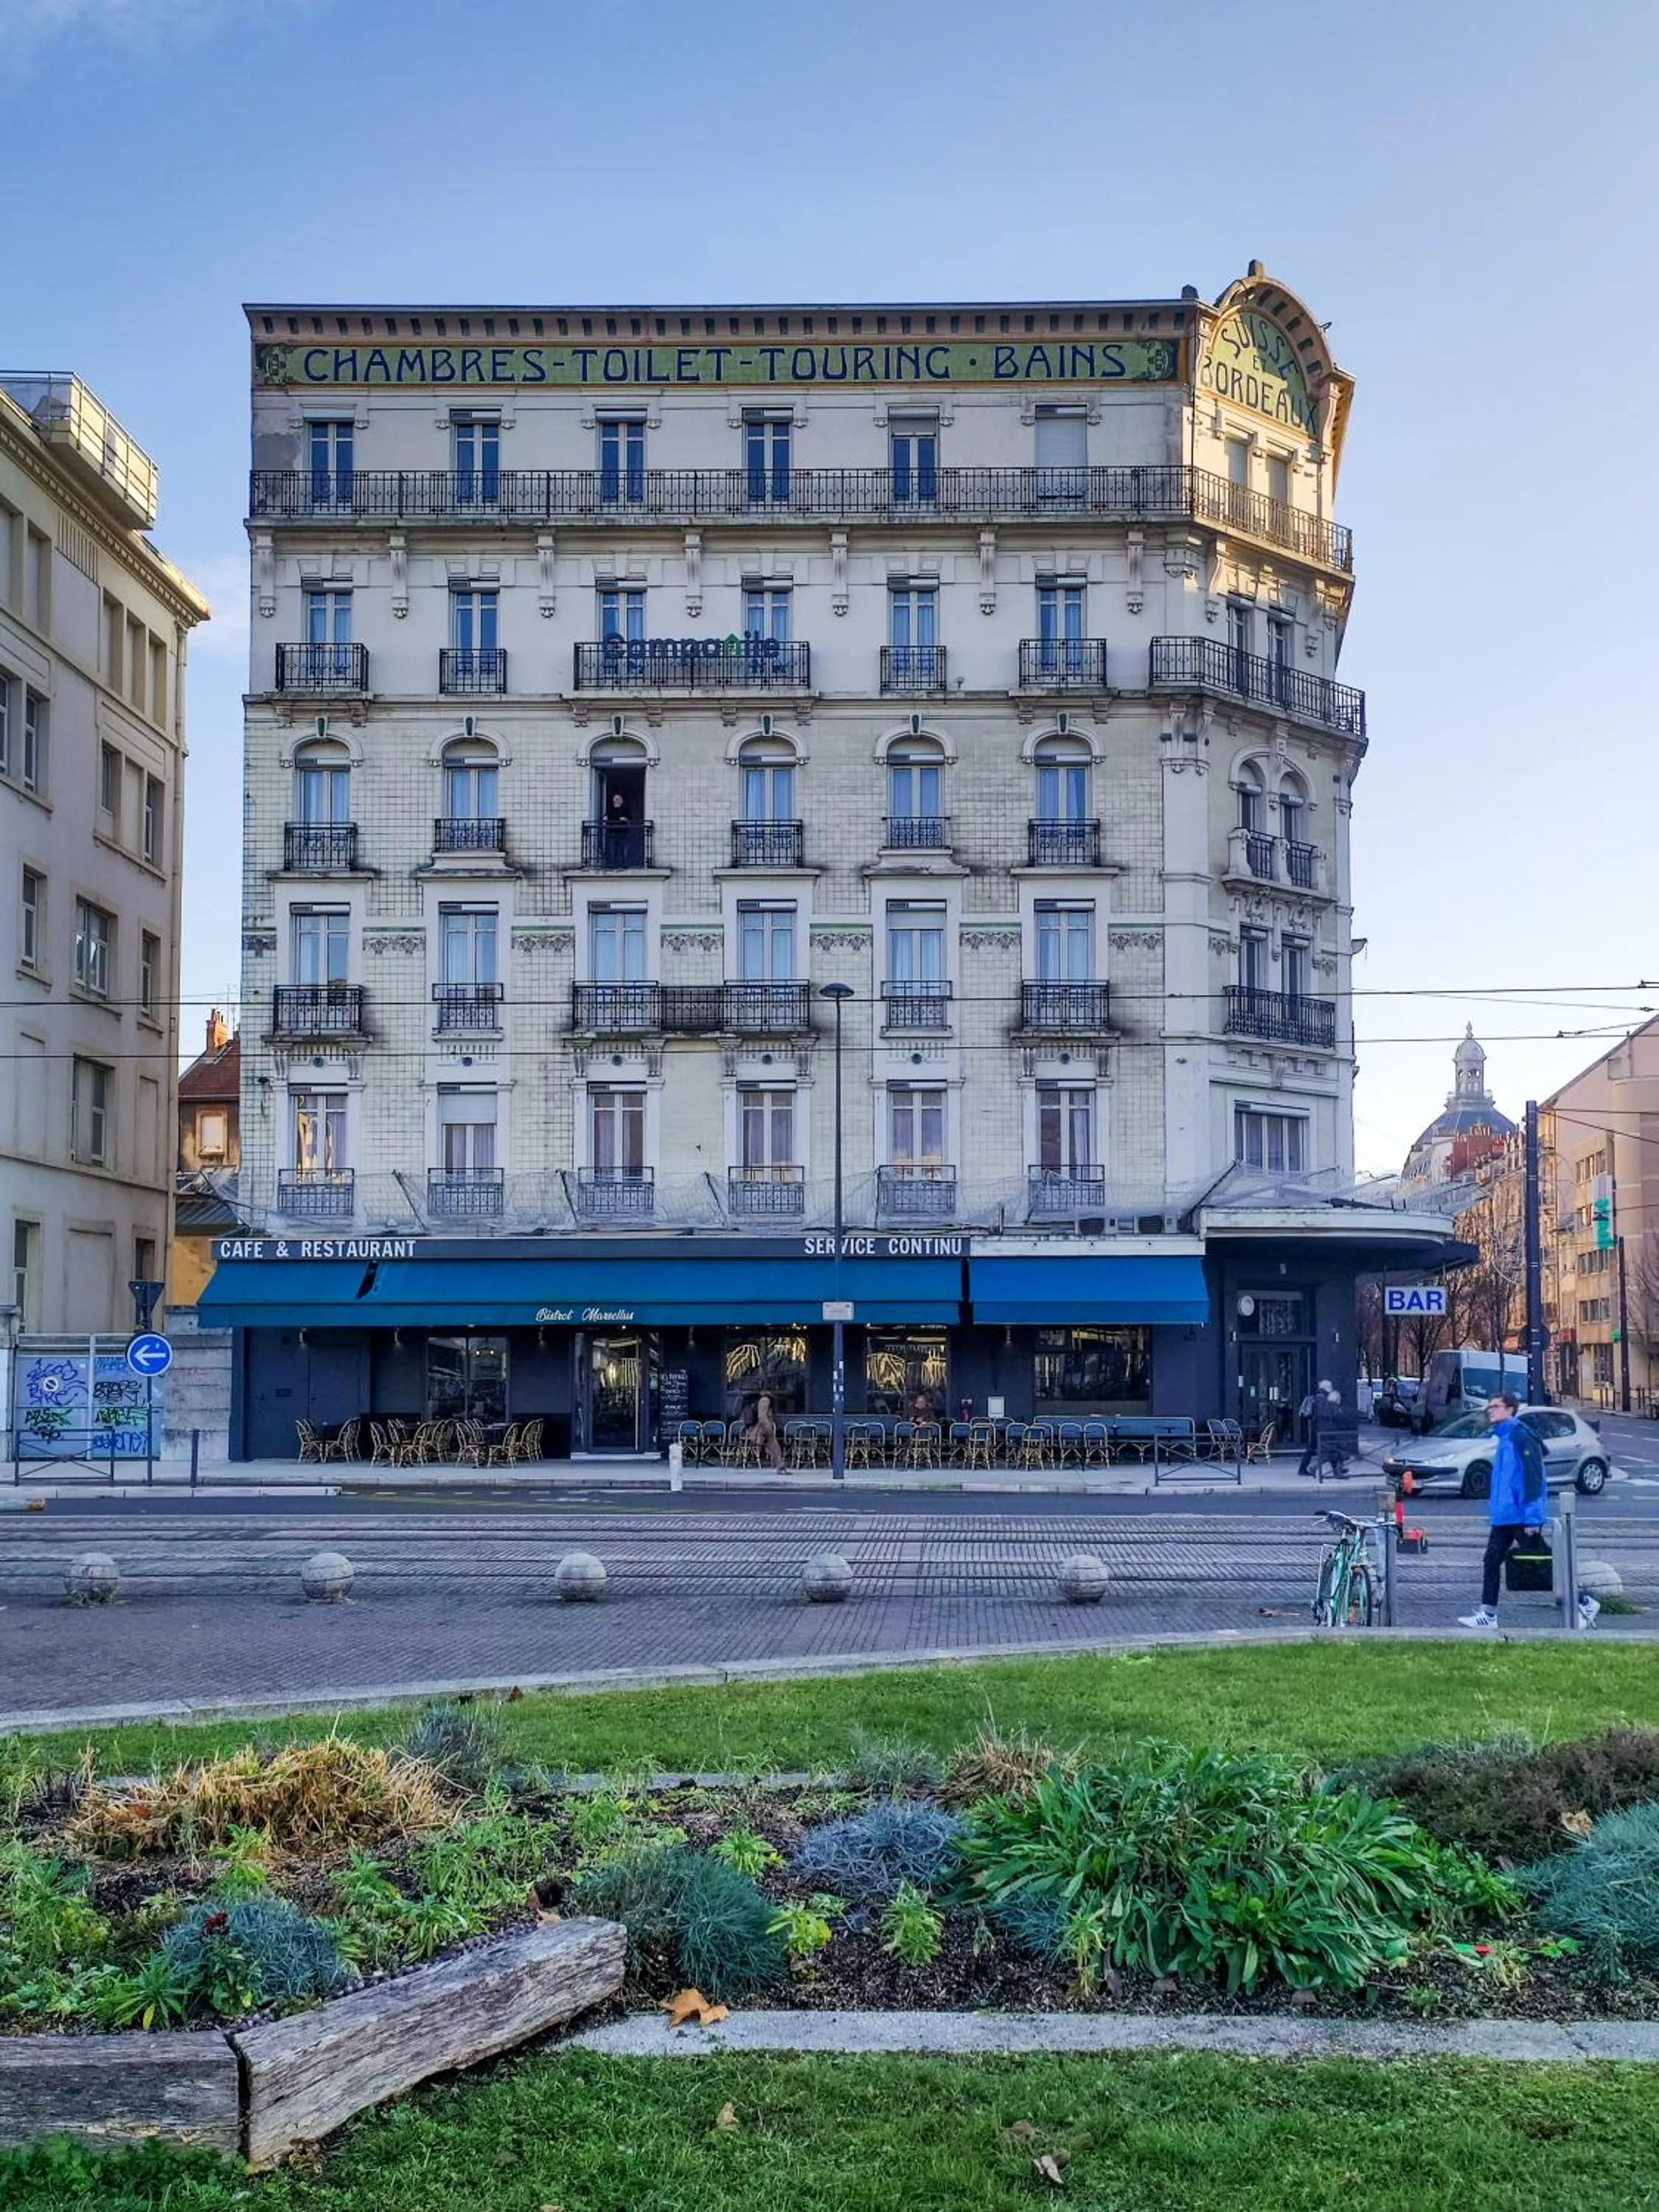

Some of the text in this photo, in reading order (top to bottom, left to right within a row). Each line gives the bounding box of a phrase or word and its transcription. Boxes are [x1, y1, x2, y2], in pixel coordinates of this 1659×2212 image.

[1221, 314, 1298, 380] SUISSE
[993, 344, 1127, 379] BAINS
[1200, 355, 1319, 435] BORDEAUX
[221, 1239, 416, 1258] CAFE & RESTAURANT
[804, 1238, 962, 1254] SERVICE CONTINU
[1388, 1290, 1443, 1310] BAR
[535, 1307, 574, 1322] Bistrot
